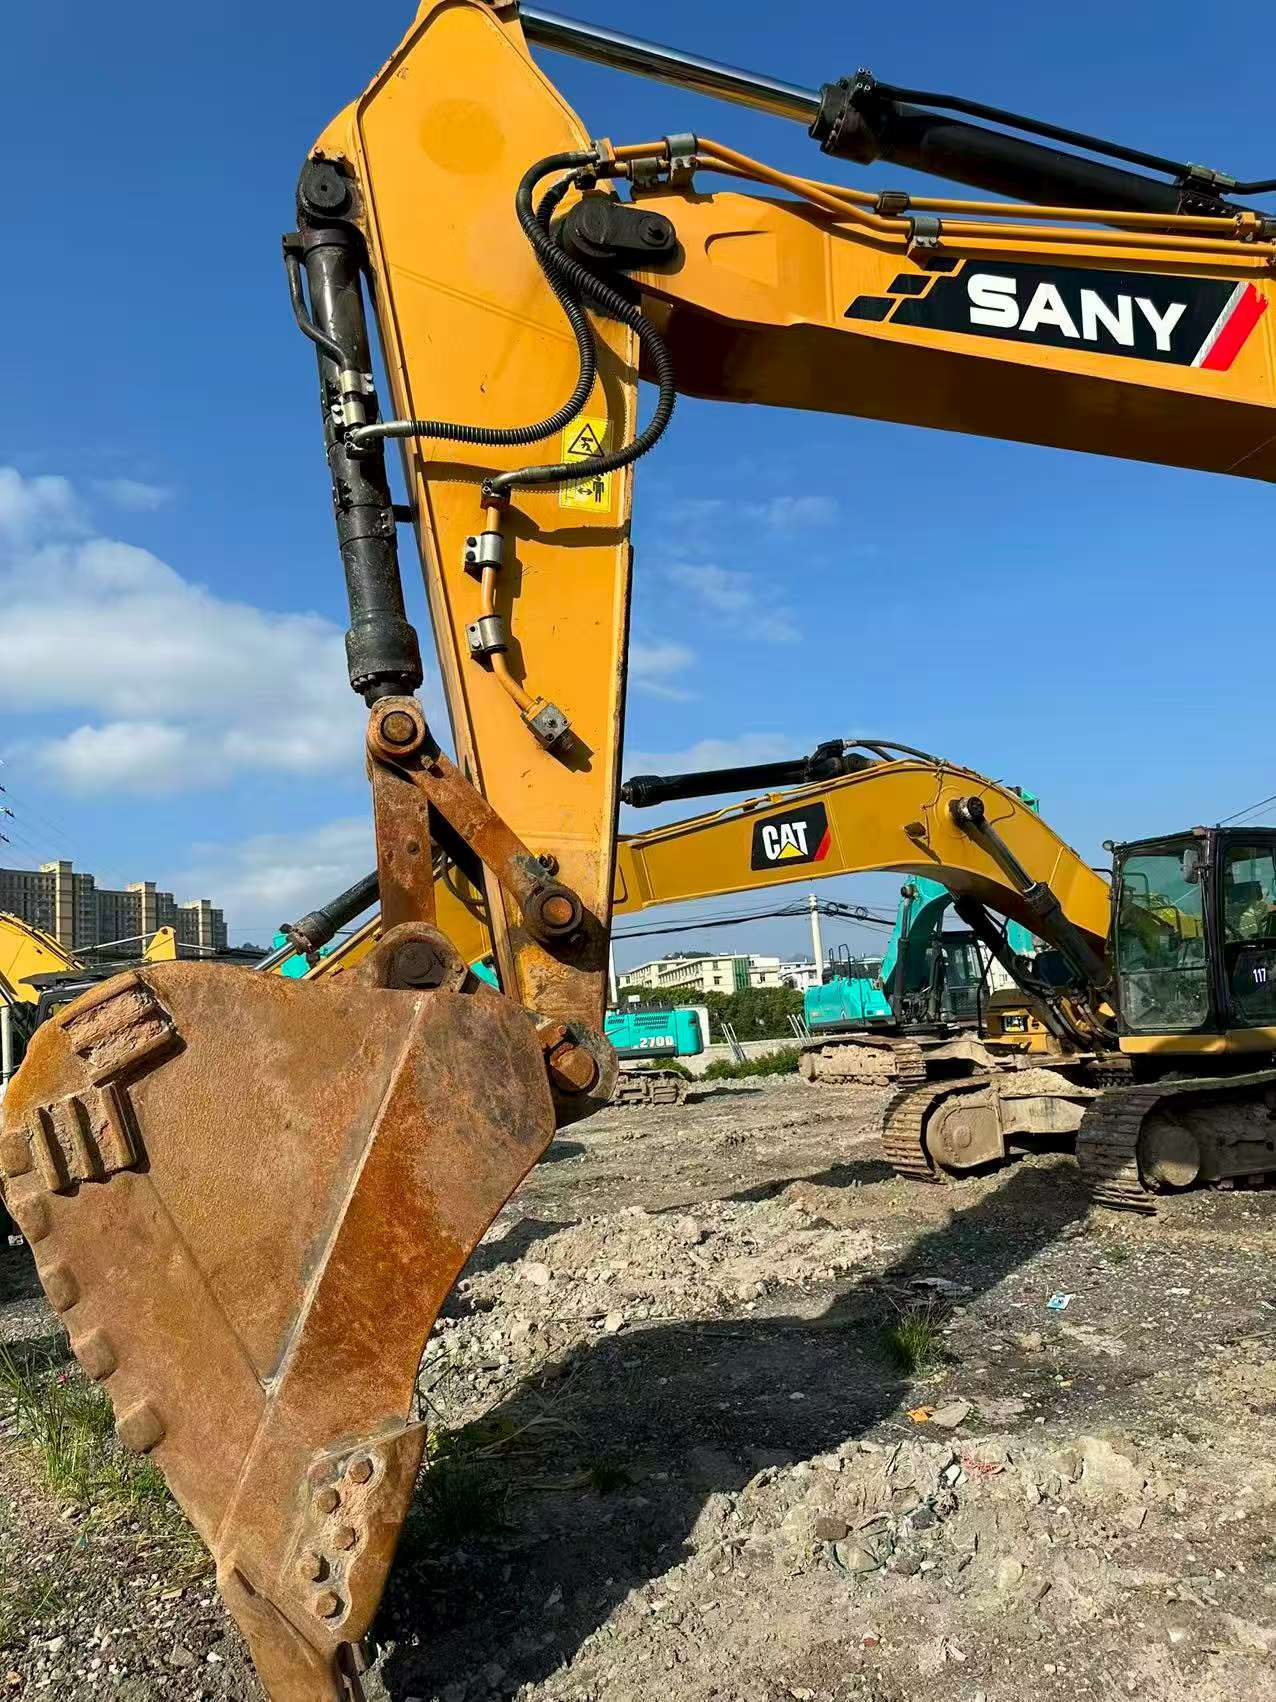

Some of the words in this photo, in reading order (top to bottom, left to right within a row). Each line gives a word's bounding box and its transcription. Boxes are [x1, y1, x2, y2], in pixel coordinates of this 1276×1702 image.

[967, 273, 1187, 352] SANY
[762, 821, 809, 861] CAT
[1252, 968, 1266, 983] 117
